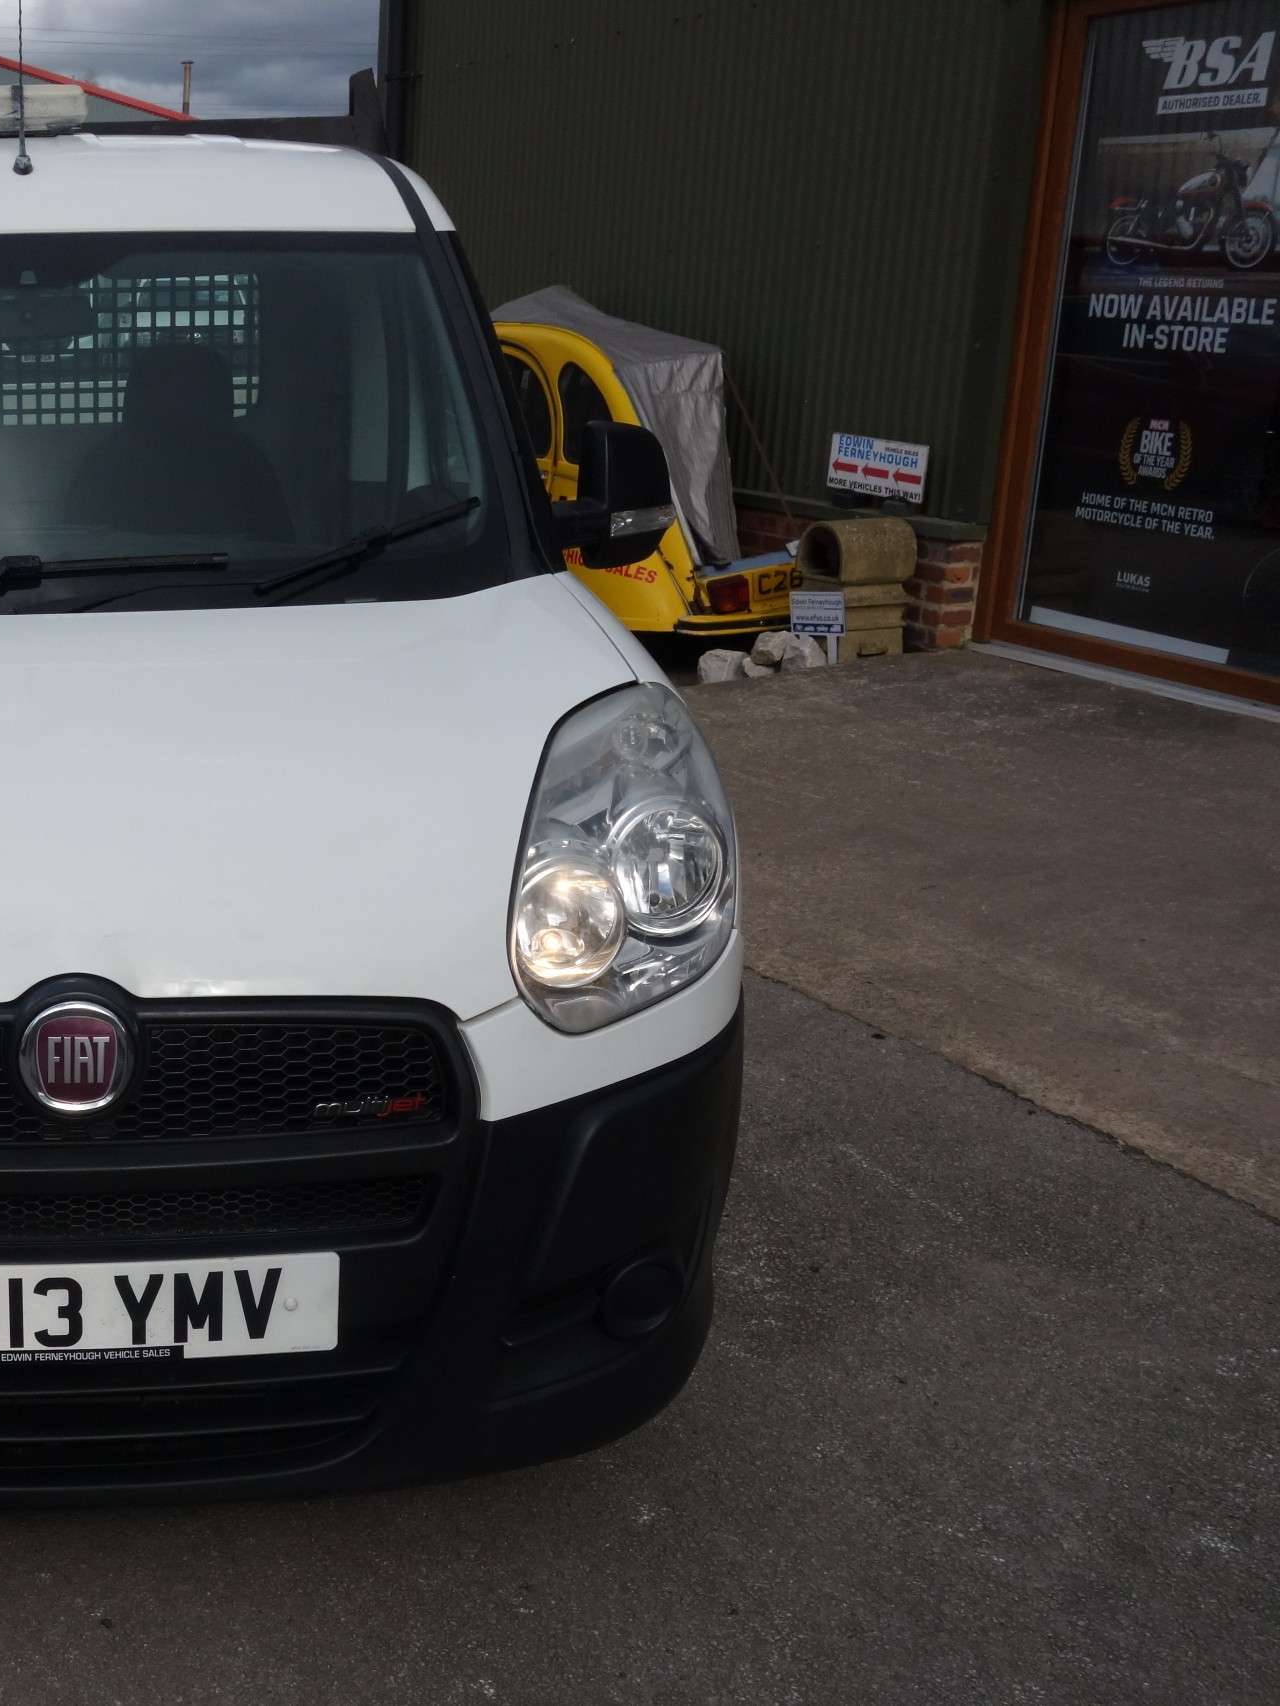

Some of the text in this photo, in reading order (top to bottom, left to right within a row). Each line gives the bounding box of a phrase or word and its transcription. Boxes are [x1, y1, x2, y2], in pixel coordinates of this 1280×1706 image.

[1162, 31, 1276, 90] BSA
[1161, 93, 1261, 111] AUTHORISED DEALER.
[1088, 292, 1278, 326] NOW AVAILABLE
[1122, 323, 1230, 354] IN-STORE
[839, 435, 874, 450] EDWIN
[1140, 430, 1174, 456] BIKE
[837, 446, 918, 469] FERNEYHOUGH
[1143, 454, 1155, 466] THE
[1156, 455, 1175, 469] YEAR
[829, 477, 847, 487] MORE
[849, 480, 882, 494] VEHICLES
[884, 487, 900, 497] THIS
[1081, 492, 1214, 523] HOME OF THE MCN RETRO
[1075, 506, 1215, 540] MOTORCYCLE OF THE YEAR.
[1116, 571, 1151, 587] LUKAS
[47, 1036, 110, 1084] FIAT
[114, 1268, 283, 1346] YMV
[1, 1353, 32, 1362] EDWIN
[34, 1351, 101, 1362] FERNEYHOUGH
[104, 1350, 140, 1360] VEHICLE
[143, 1349, 170, 1359] SALES
